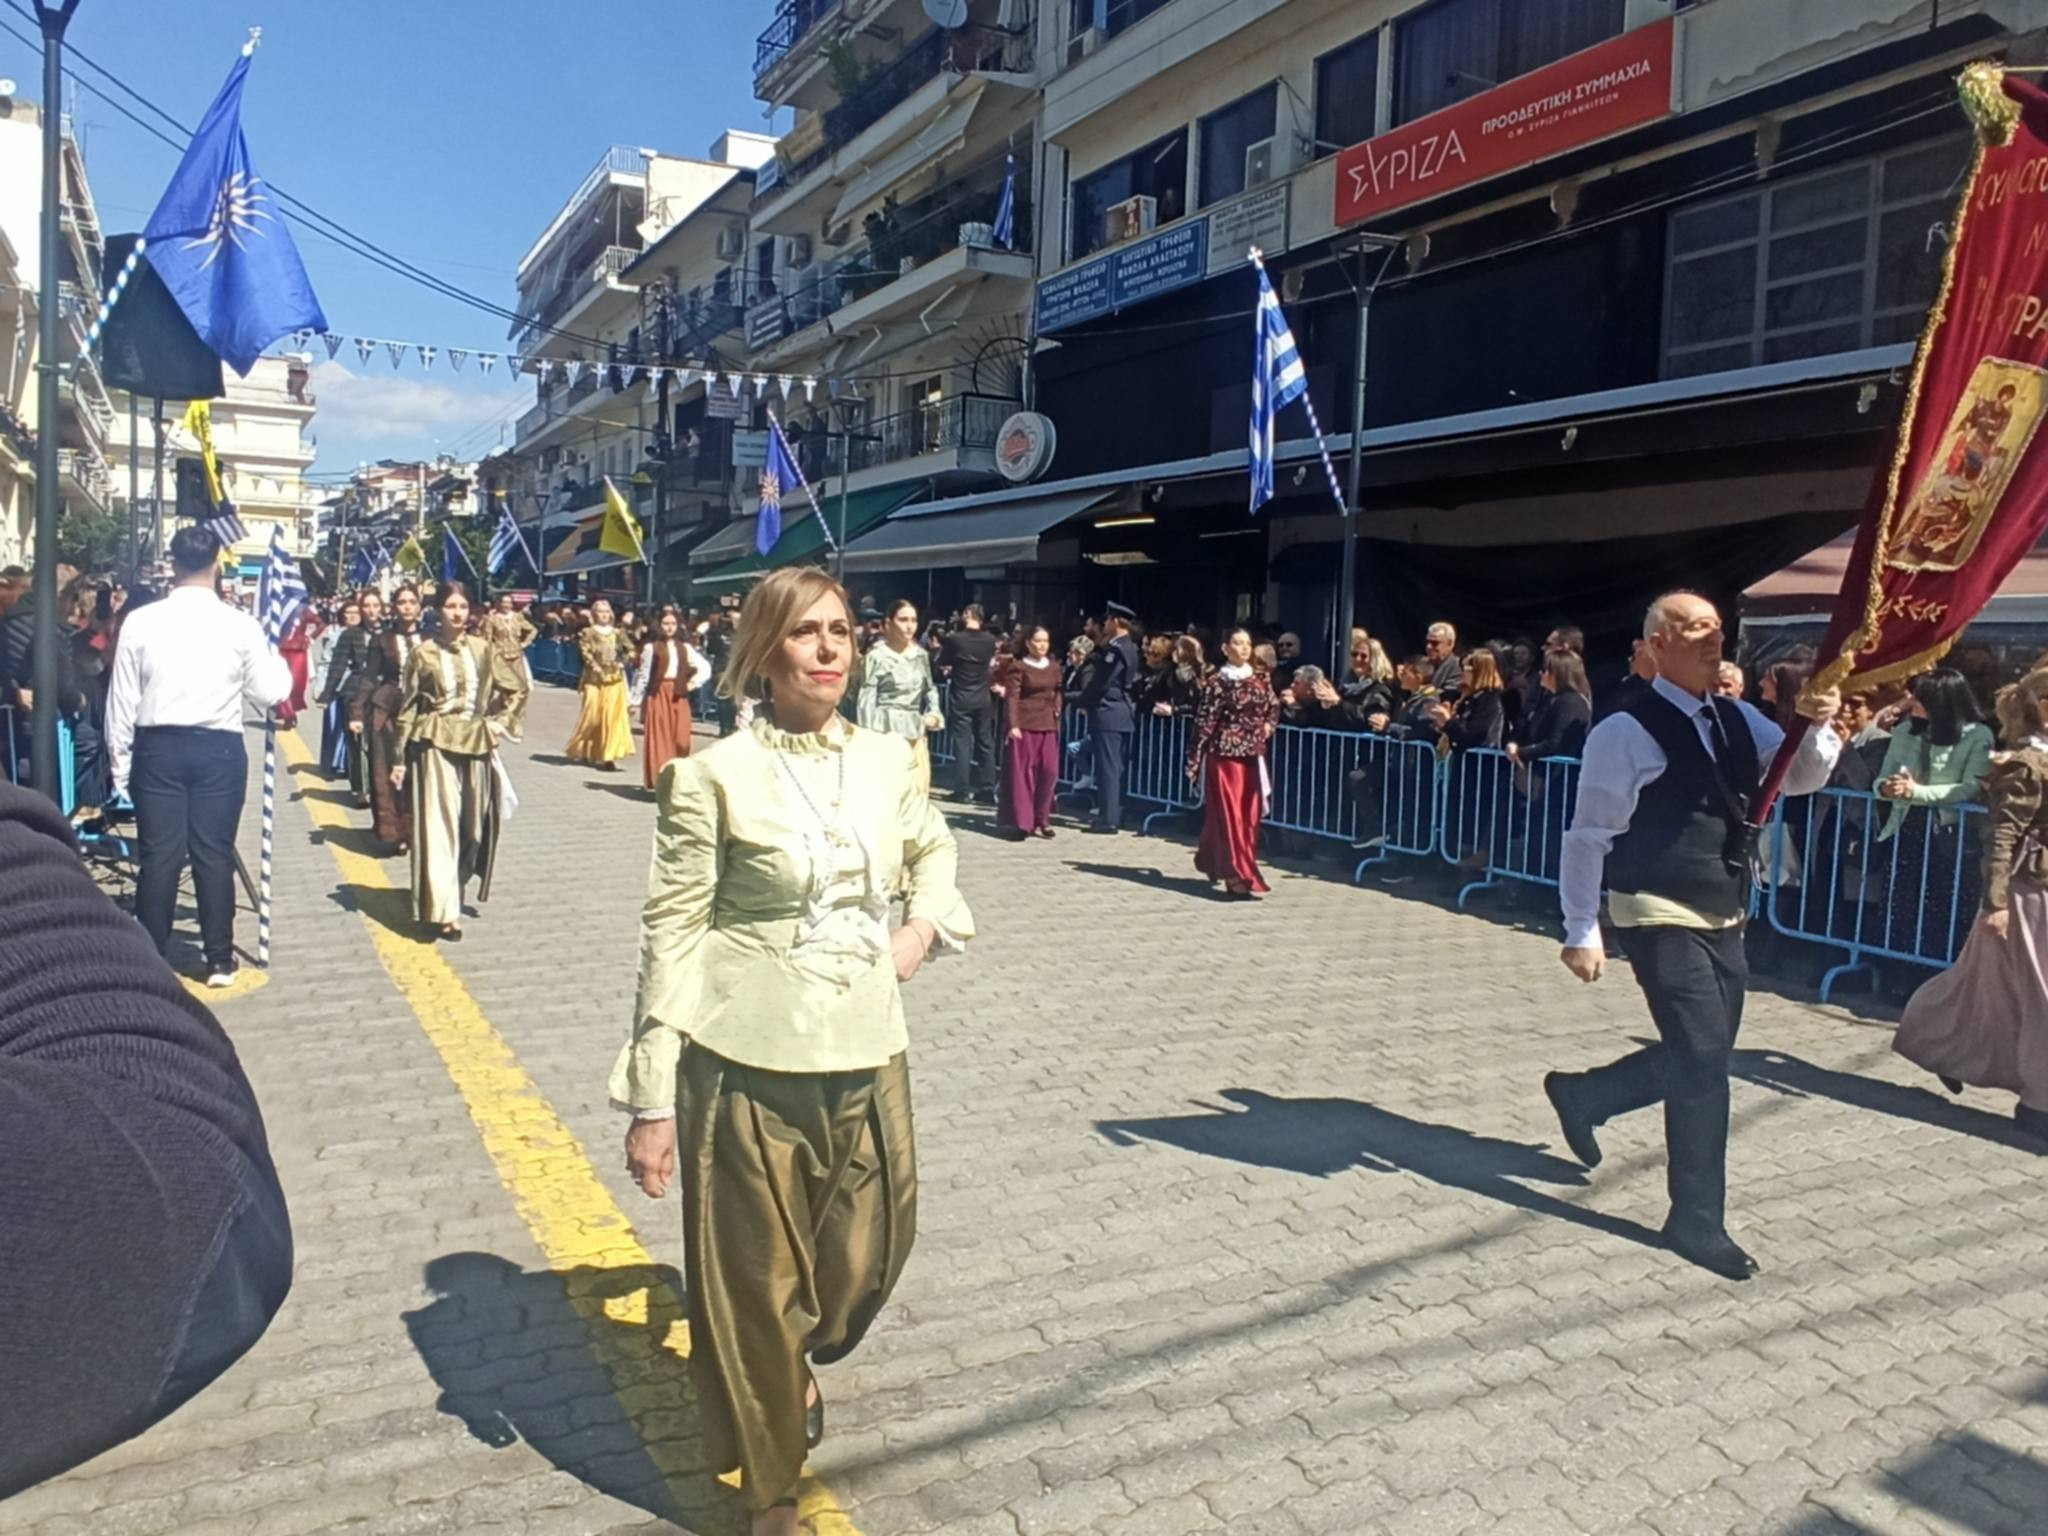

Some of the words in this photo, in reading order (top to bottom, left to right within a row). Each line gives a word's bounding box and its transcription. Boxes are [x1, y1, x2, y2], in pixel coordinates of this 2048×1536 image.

[1482, 89, 1572, 135] ΠΡΟΟΔΕΥΤΙΚΗ
[1575, 59, 1651, 101] ΣΥΜΜΑΧΙΑ
[1347, 129, 1467, 203] ΣΥΡΙΖΑ
